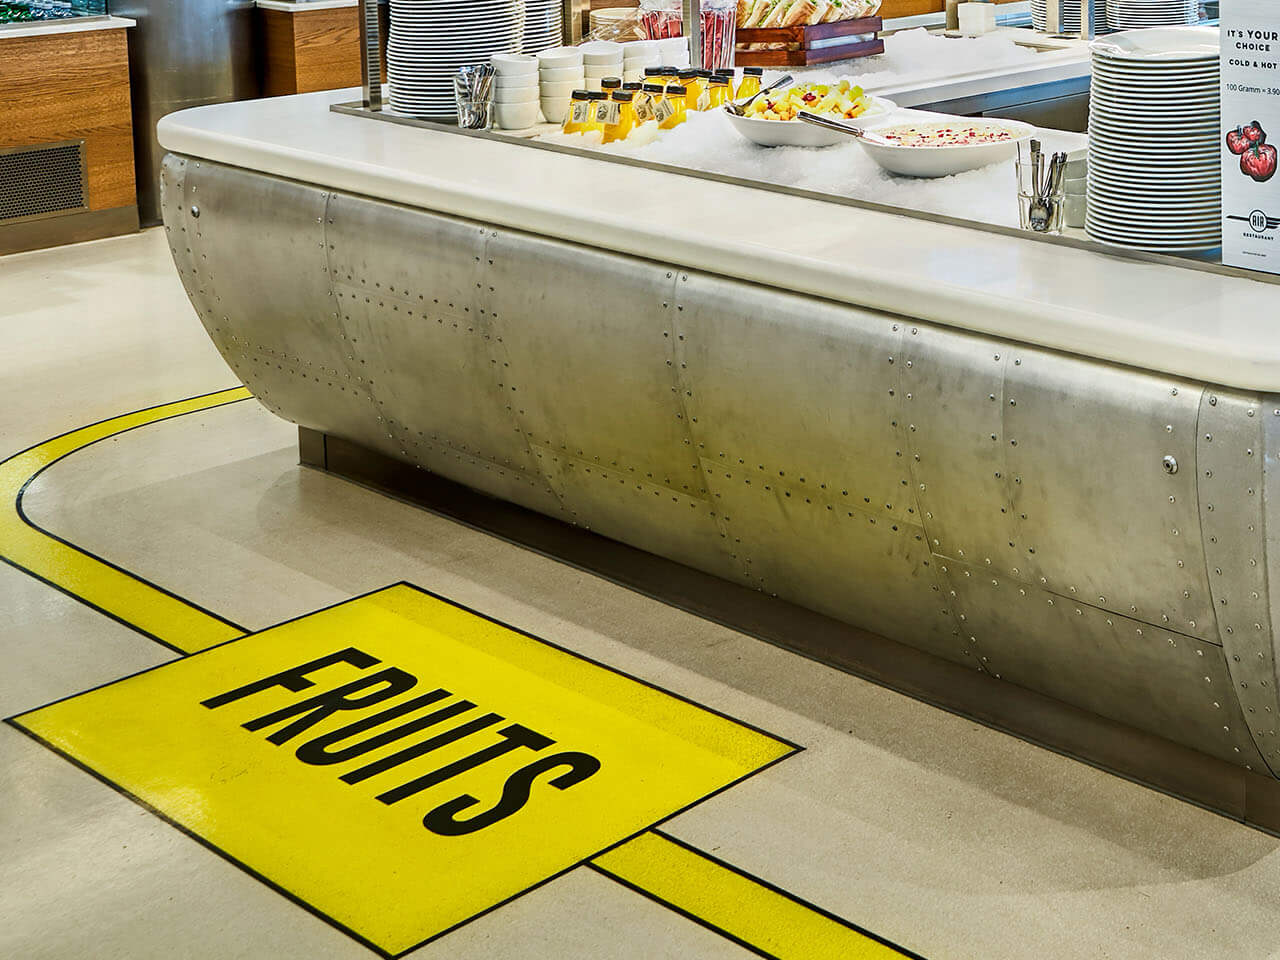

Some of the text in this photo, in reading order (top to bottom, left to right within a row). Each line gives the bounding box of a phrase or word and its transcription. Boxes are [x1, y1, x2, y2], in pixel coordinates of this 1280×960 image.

[1227, 30, 1279, 41] IT'S YOUR
[1235, 42, 1271, 52] CHOICE
[1229, 58, 1250, 67] COLD
[1226, 83, 1237, 91] 100
[1238, 84, 1261, 94] Gramm
[1252, 215, 1264, 227] AIR
[1243, 232, 1274, 241] RESTAURANT
[199, 646, 602, 837] FRUITS
